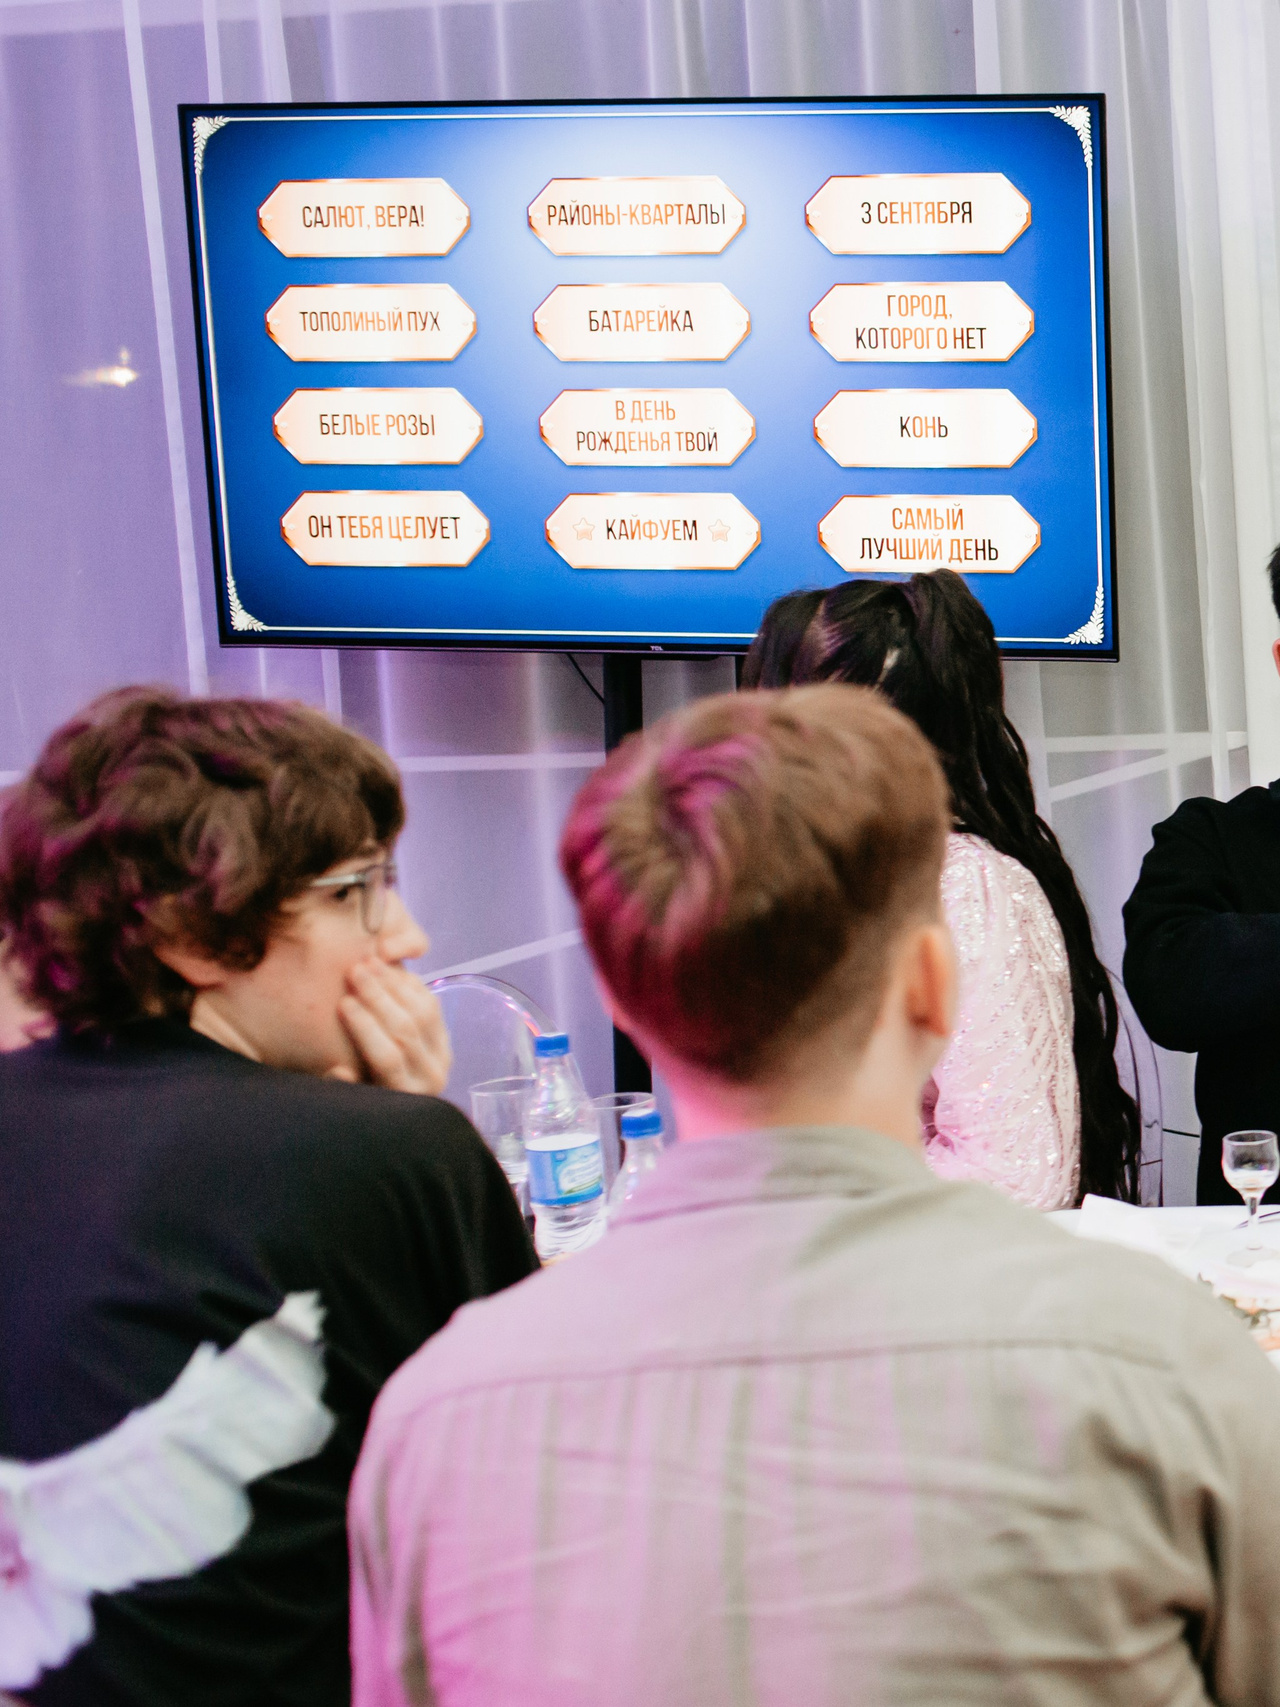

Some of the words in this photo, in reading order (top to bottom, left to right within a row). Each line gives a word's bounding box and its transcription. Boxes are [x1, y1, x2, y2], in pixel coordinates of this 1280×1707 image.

[302, 204, 371, 231] САЛЮТ,
[375, 204, 425, 228] ВЕРА!
[547, 200, 726, 226] РАЙОНЫ-КВАРТАЛЫ
[861, 202, 873, 224] 3
[878, 201, 973, 224] СЕНТЯБРЯ
[299, 306, 403, 332] ТОПОЛИНЫЙ
[408, 311, 441, 332] ПУХ
[588, 305, 694, 332] БАТАРЕЙКА
[886, 294, 953, 319] ГОРОД,
[856, 327, 948, 350] КОТОРОГО
[953, 327, 986, 350] НЕТ
[615, 400, 626, 421] В
[631, 400, 676, 423] ДЕНЬ
[319, 414, 382, 436] БЕЛЫЕ
[386, 414, 436, 436] РОЗЫ
[899, 415, 949, 438] КОНЬ
[576, 431, 671, 453] РОЖДЕНЬЯ
[675, 427, 718, 451] ТВОЙ
[308, 515, 332, 539] ОН
[337, 515, 384, 539] ТЕБЯ
[388, 516, 461, 541] ЦЕЛУЕТ
[606, 514, 698, 541] КАЙФУЕМ
[891, 503, 963, 531] САМЫЙ
[860, 534, 943, 560] ЛУЧШИЙ
[948, 537, 999, 563] ДЕНЬ
